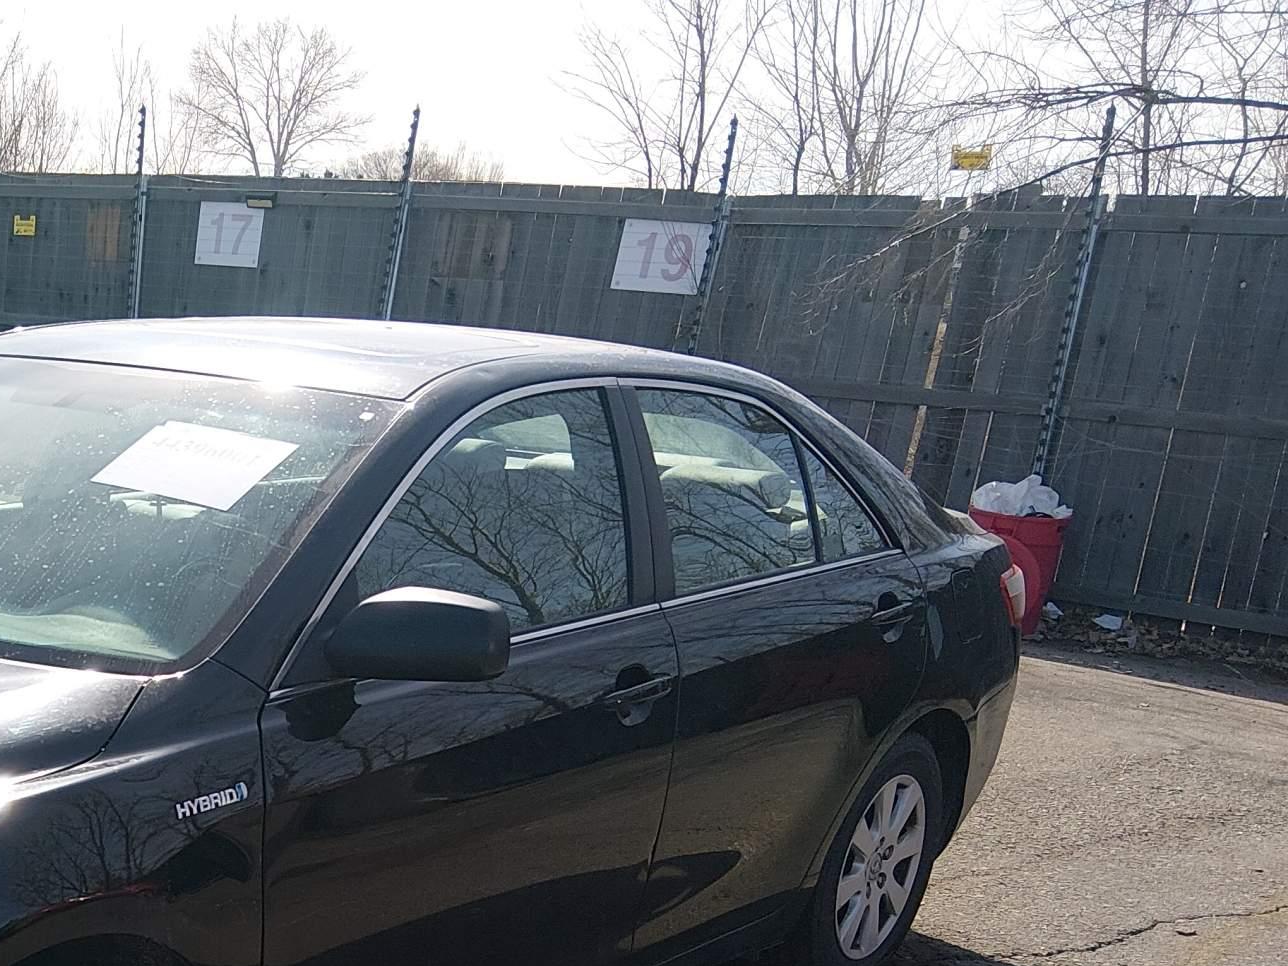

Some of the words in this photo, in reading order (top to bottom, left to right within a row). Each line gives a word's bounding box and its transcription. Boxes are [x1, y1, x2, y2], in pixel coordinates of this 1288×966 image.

[210, 212, 253, 255] 17
[637, 232, 693, 282] 19
[175, 788, 241, 820] HYBRID
